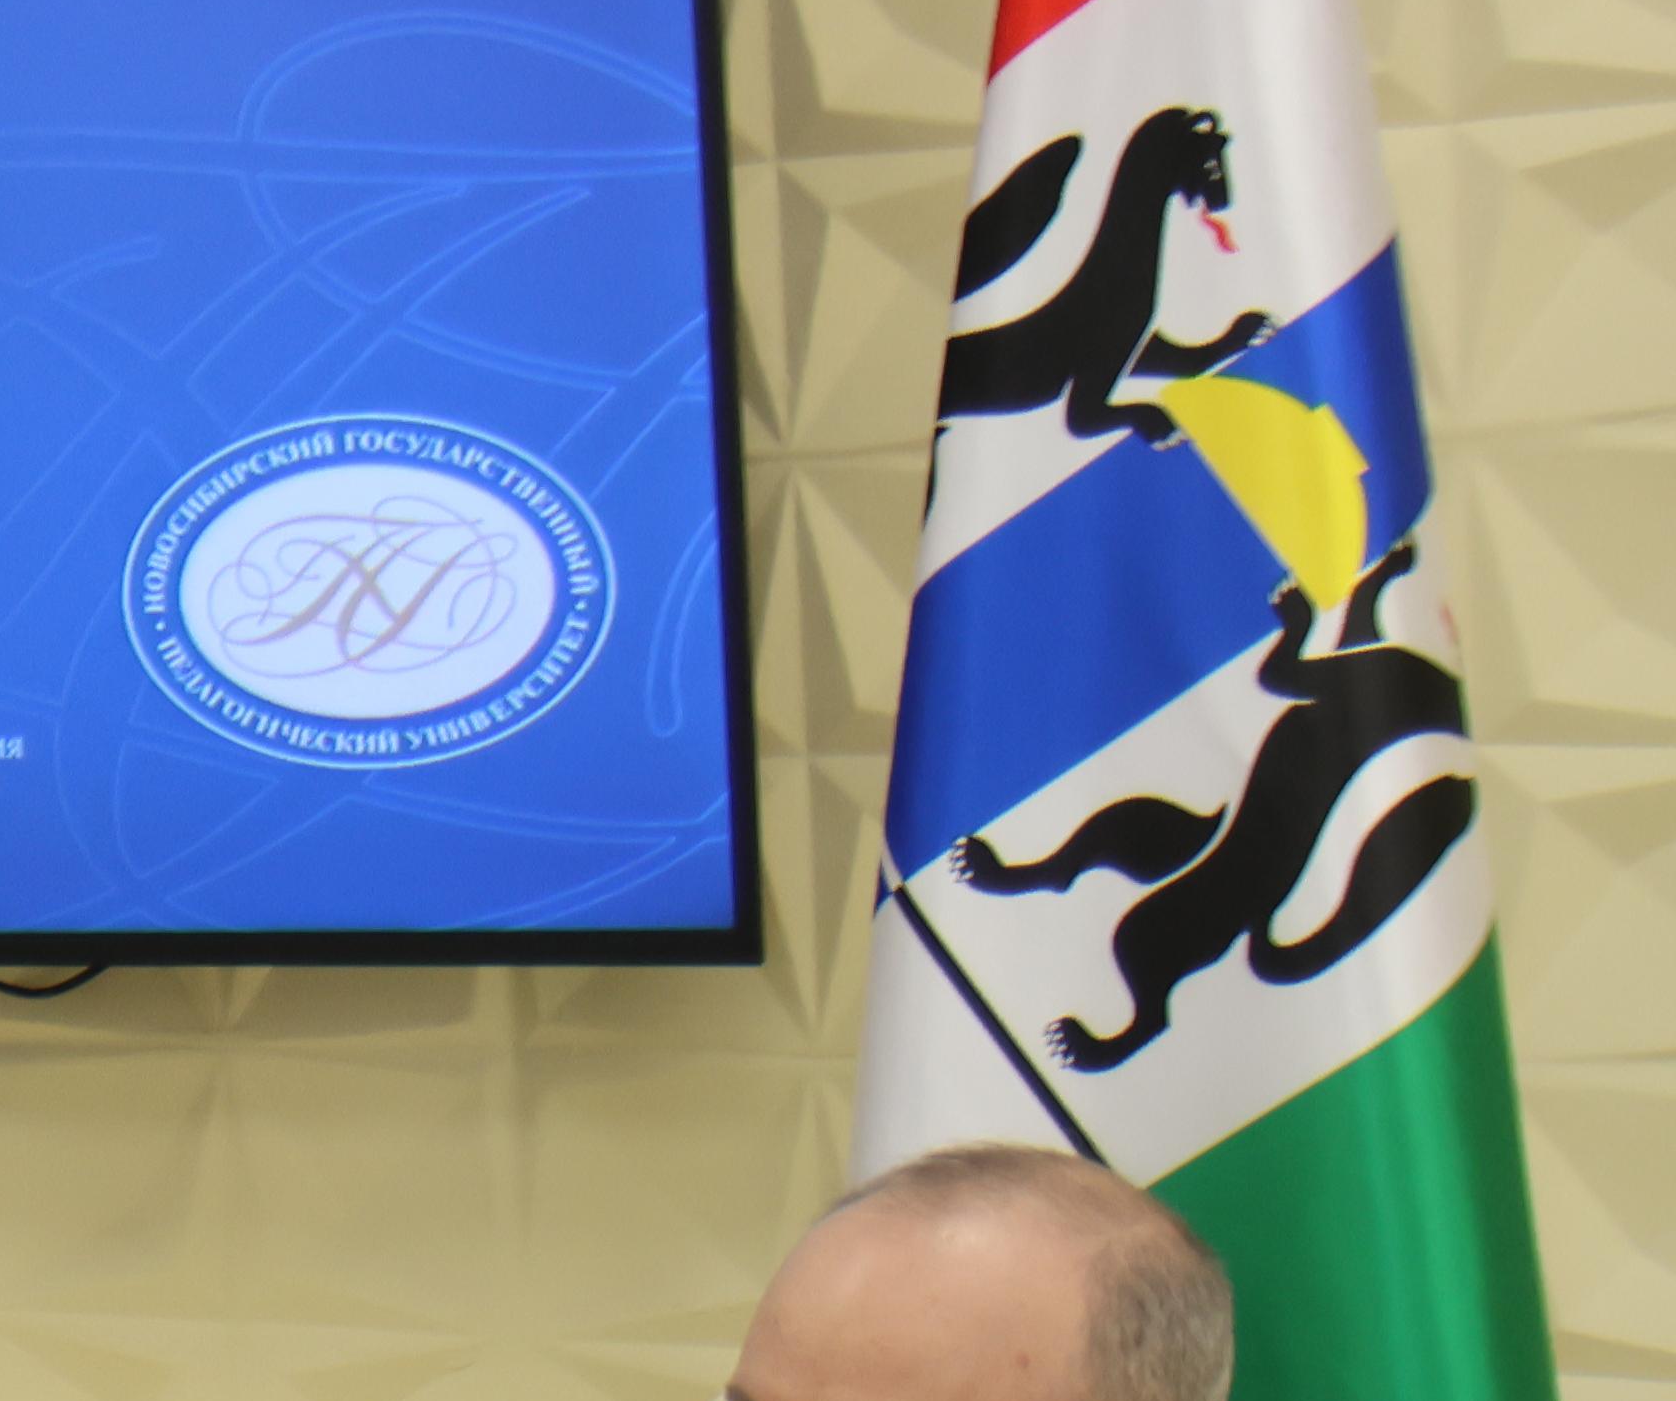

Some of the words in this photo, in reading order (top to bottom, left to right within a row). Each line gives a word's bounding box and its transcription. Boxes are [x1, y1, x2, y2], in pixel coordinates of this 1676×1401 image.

[142, 430, 335, 615] НОВОСИБИРСКИЙ
[343, 428, 599, 596] ГОСУДАРСТВЕННЫЙ
[156, 636, 399, 754] ПЕДАГОГИЧЕСКИЙ
[406, 617, 590, 750] УНИВЕРСИТЕТ
